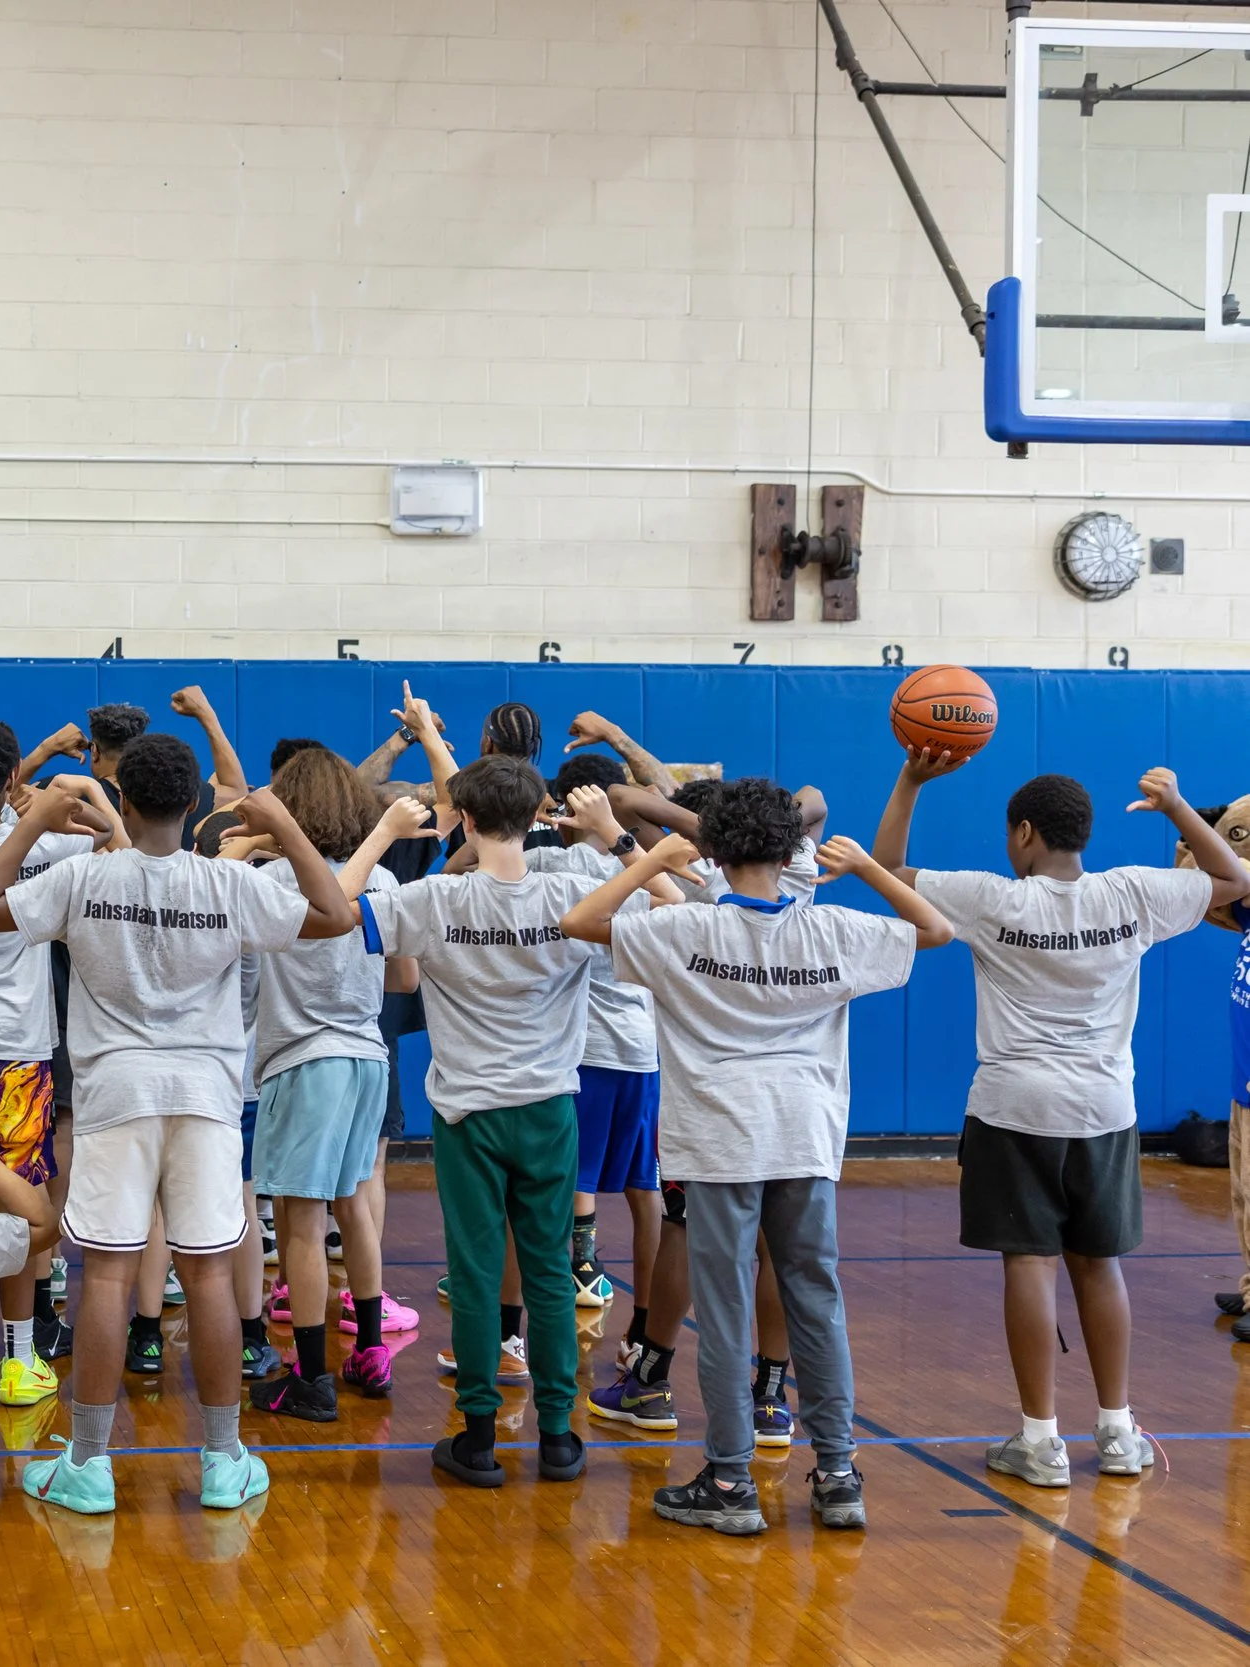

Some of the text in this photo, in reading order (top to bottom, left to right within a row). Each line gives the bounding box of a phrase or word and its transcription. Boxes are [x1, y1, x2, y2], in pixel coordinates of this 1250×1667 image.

[100, 636, 124, 659] 4
[336, 639, 359, 660] 5
[538, 641, 561, 662] 6
[732, 642, 755, 665] 7
[1107, 646, 1129, 670] 9
[930, 703, 994, 724] Wilson
[83, 899, 228, 929] Jahsaiah Watson
[444, 925, 570, 946] Jahsaiah Wats
[996, 920, 1139, 950] Jahsaiah Watson
[686, 953, 840, 986] Jahsaiah Watson
